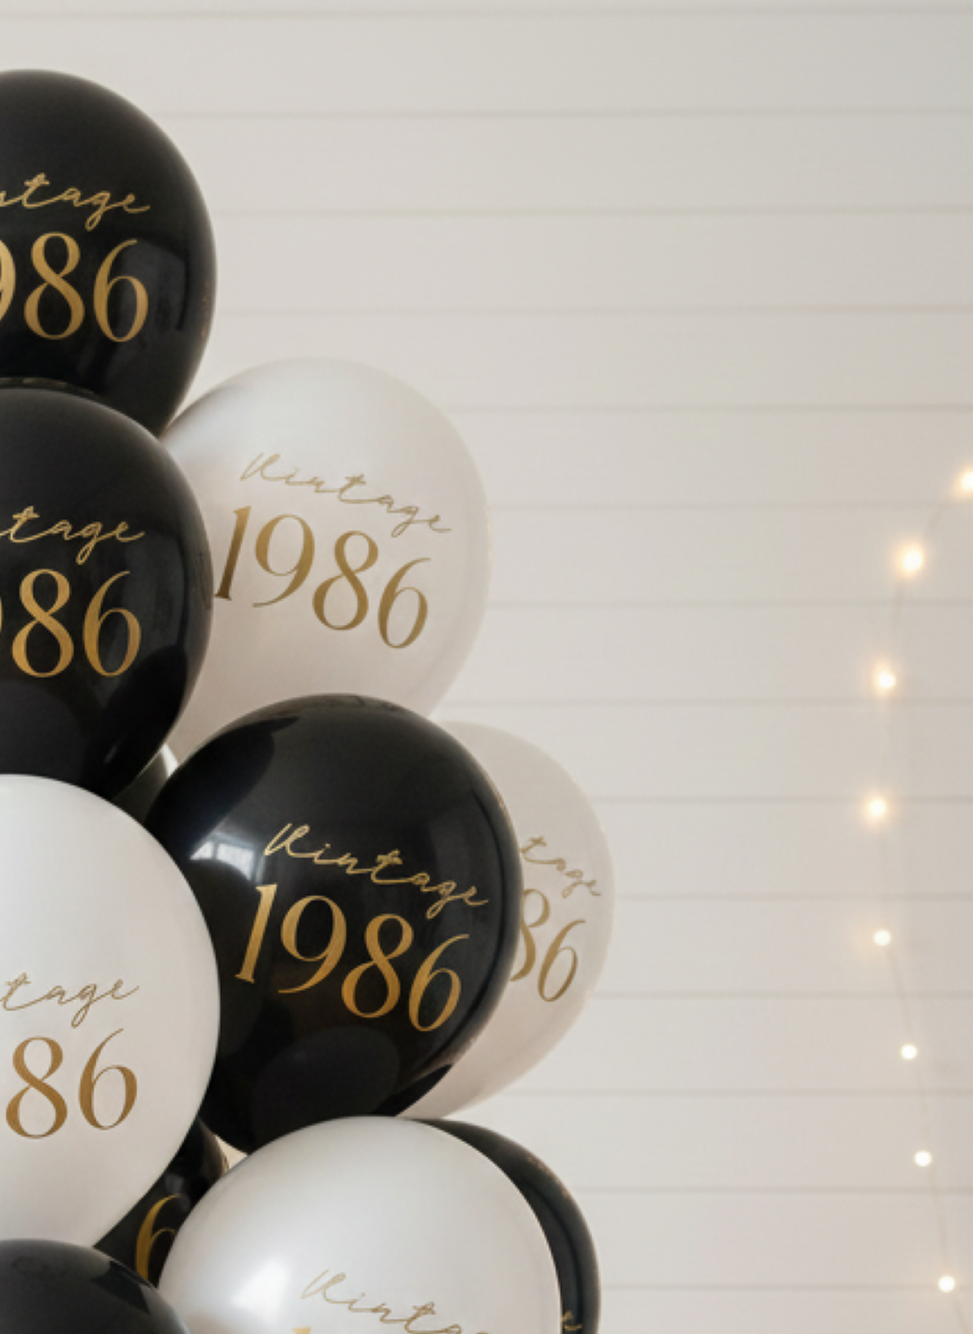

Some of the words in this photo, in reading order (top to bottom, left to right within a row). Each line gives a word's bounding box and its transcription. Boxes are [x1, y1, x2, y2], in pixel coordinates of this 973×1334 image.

[240, 452, 452, 537] Vintage
[214, 505, 430, 649] 1986
[264, 823, 489, 920] Vintage
[233, 883, 471, 1033] 1986
